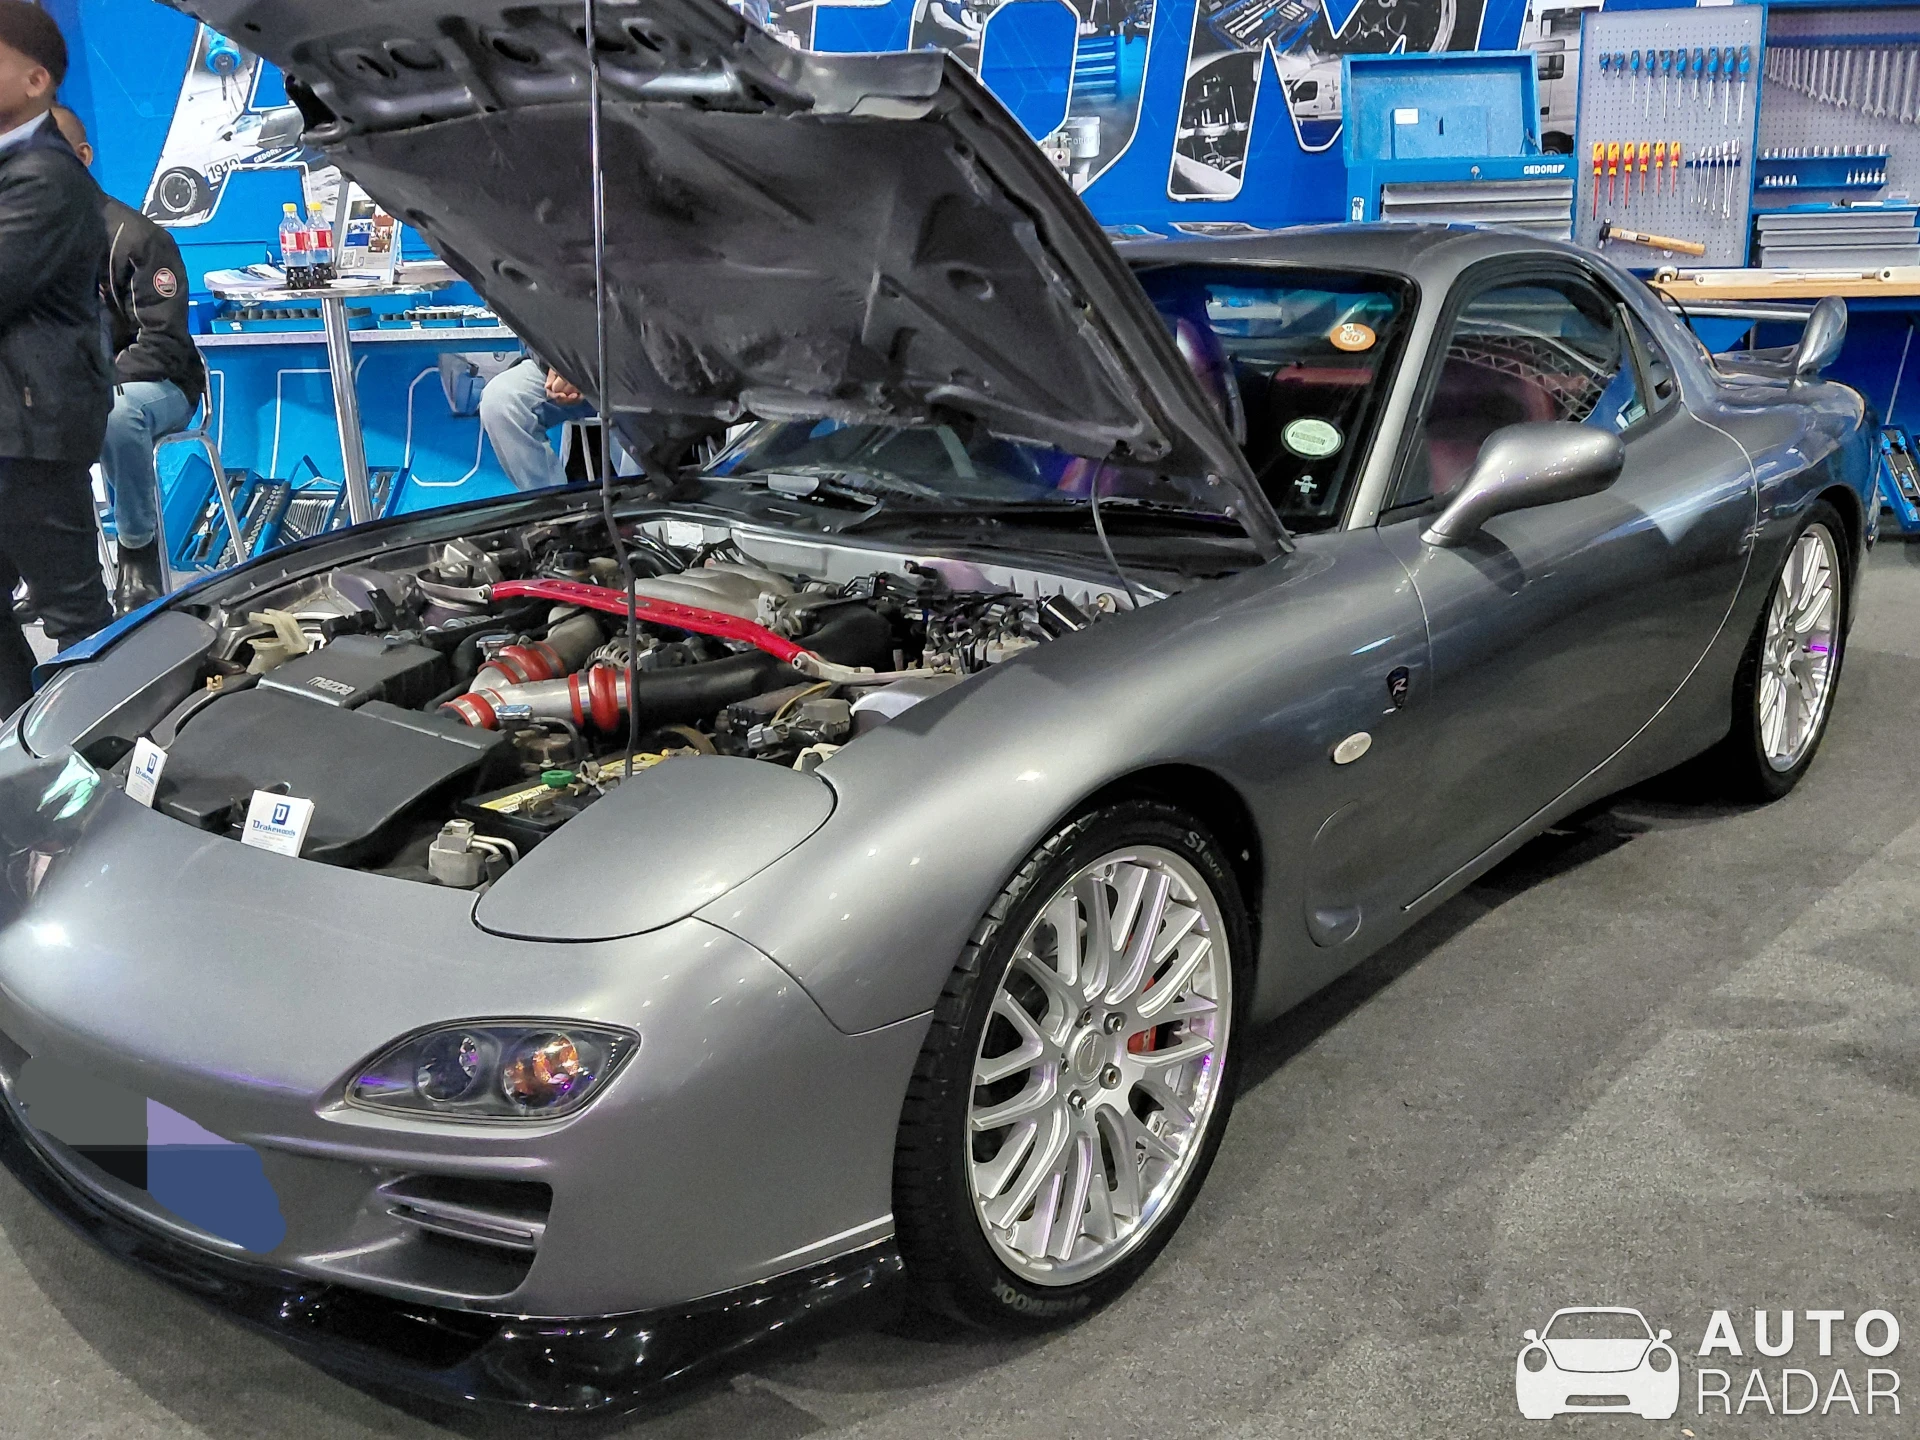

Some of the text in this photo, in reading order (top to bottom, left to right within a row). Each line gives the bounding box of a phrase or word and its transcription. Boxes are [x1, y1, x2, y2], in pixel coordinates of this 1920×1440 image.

[1523, 164, 1560, 175] GEDORE
[306, 676, 356, 696] mazda
[252, 819, 296, 837] Drakewoods
[1183, 831, 1207, 853] S1
